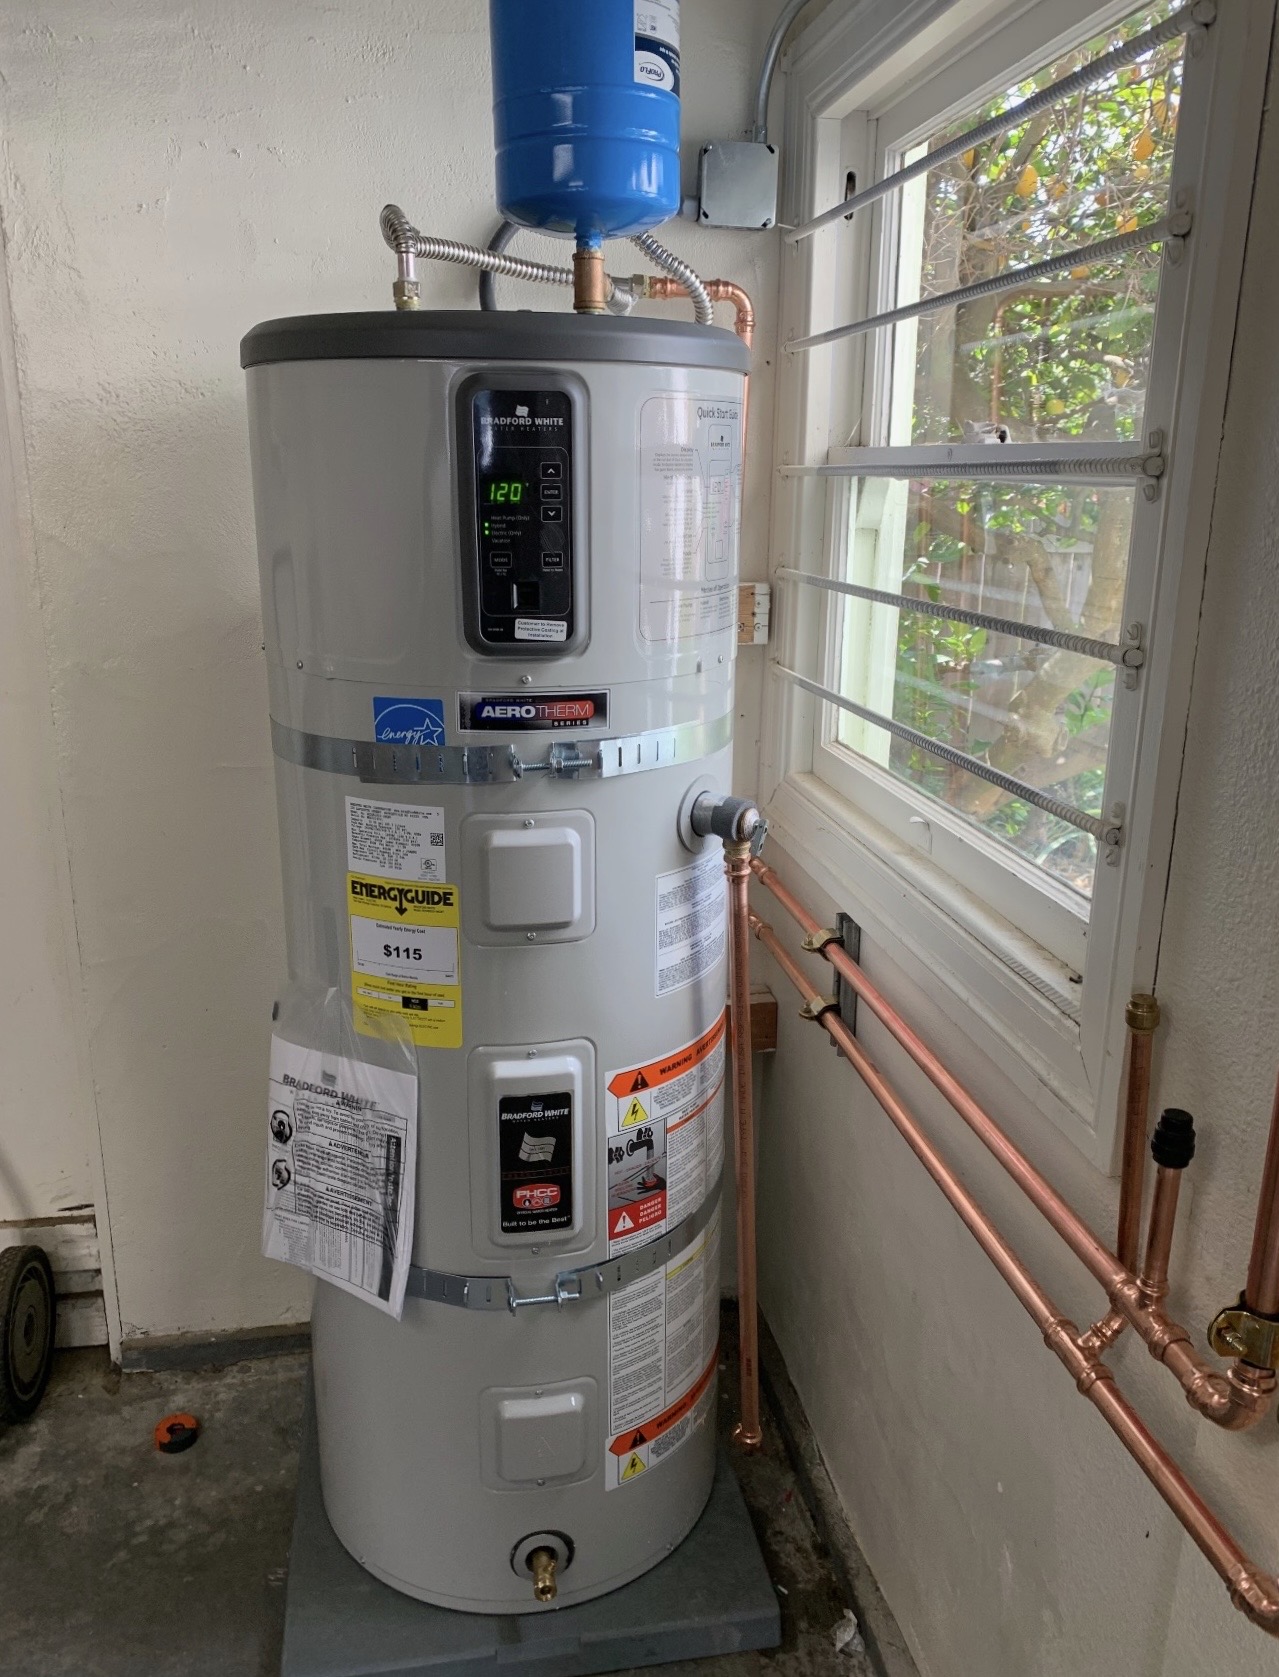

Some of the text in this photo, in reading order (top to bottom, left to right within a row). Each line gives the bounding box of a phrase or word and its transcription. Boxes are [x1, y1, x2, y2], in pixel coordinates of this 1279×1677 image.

[640, 66, 662, 78] PROFLO
[697, 407, 716, 420] Quick
[480, 417, 564, 426] BRADFORD WHITE
[490, 483, 522, 501] 120
[377, 727, 421, 745] energy
[351, 879, 454, 907] ENERGYGUIDE
[383, 943, 423, 961] $115
[659, 1054, 692, 1075] WARNING
[283, 1074, 339, 1099] BRADFORD
[501, 1108, 569, 1120] BRADFORD WHITE
[739, 1119, 747, 1141] TYPE
[516, 1187, 558, 1199] PHCC
[640, 1197, 661, 1211] DANGER
[640, 1204, 661, 1218] DANGER
[639, 1211, 662, 1225] PELIGRO
